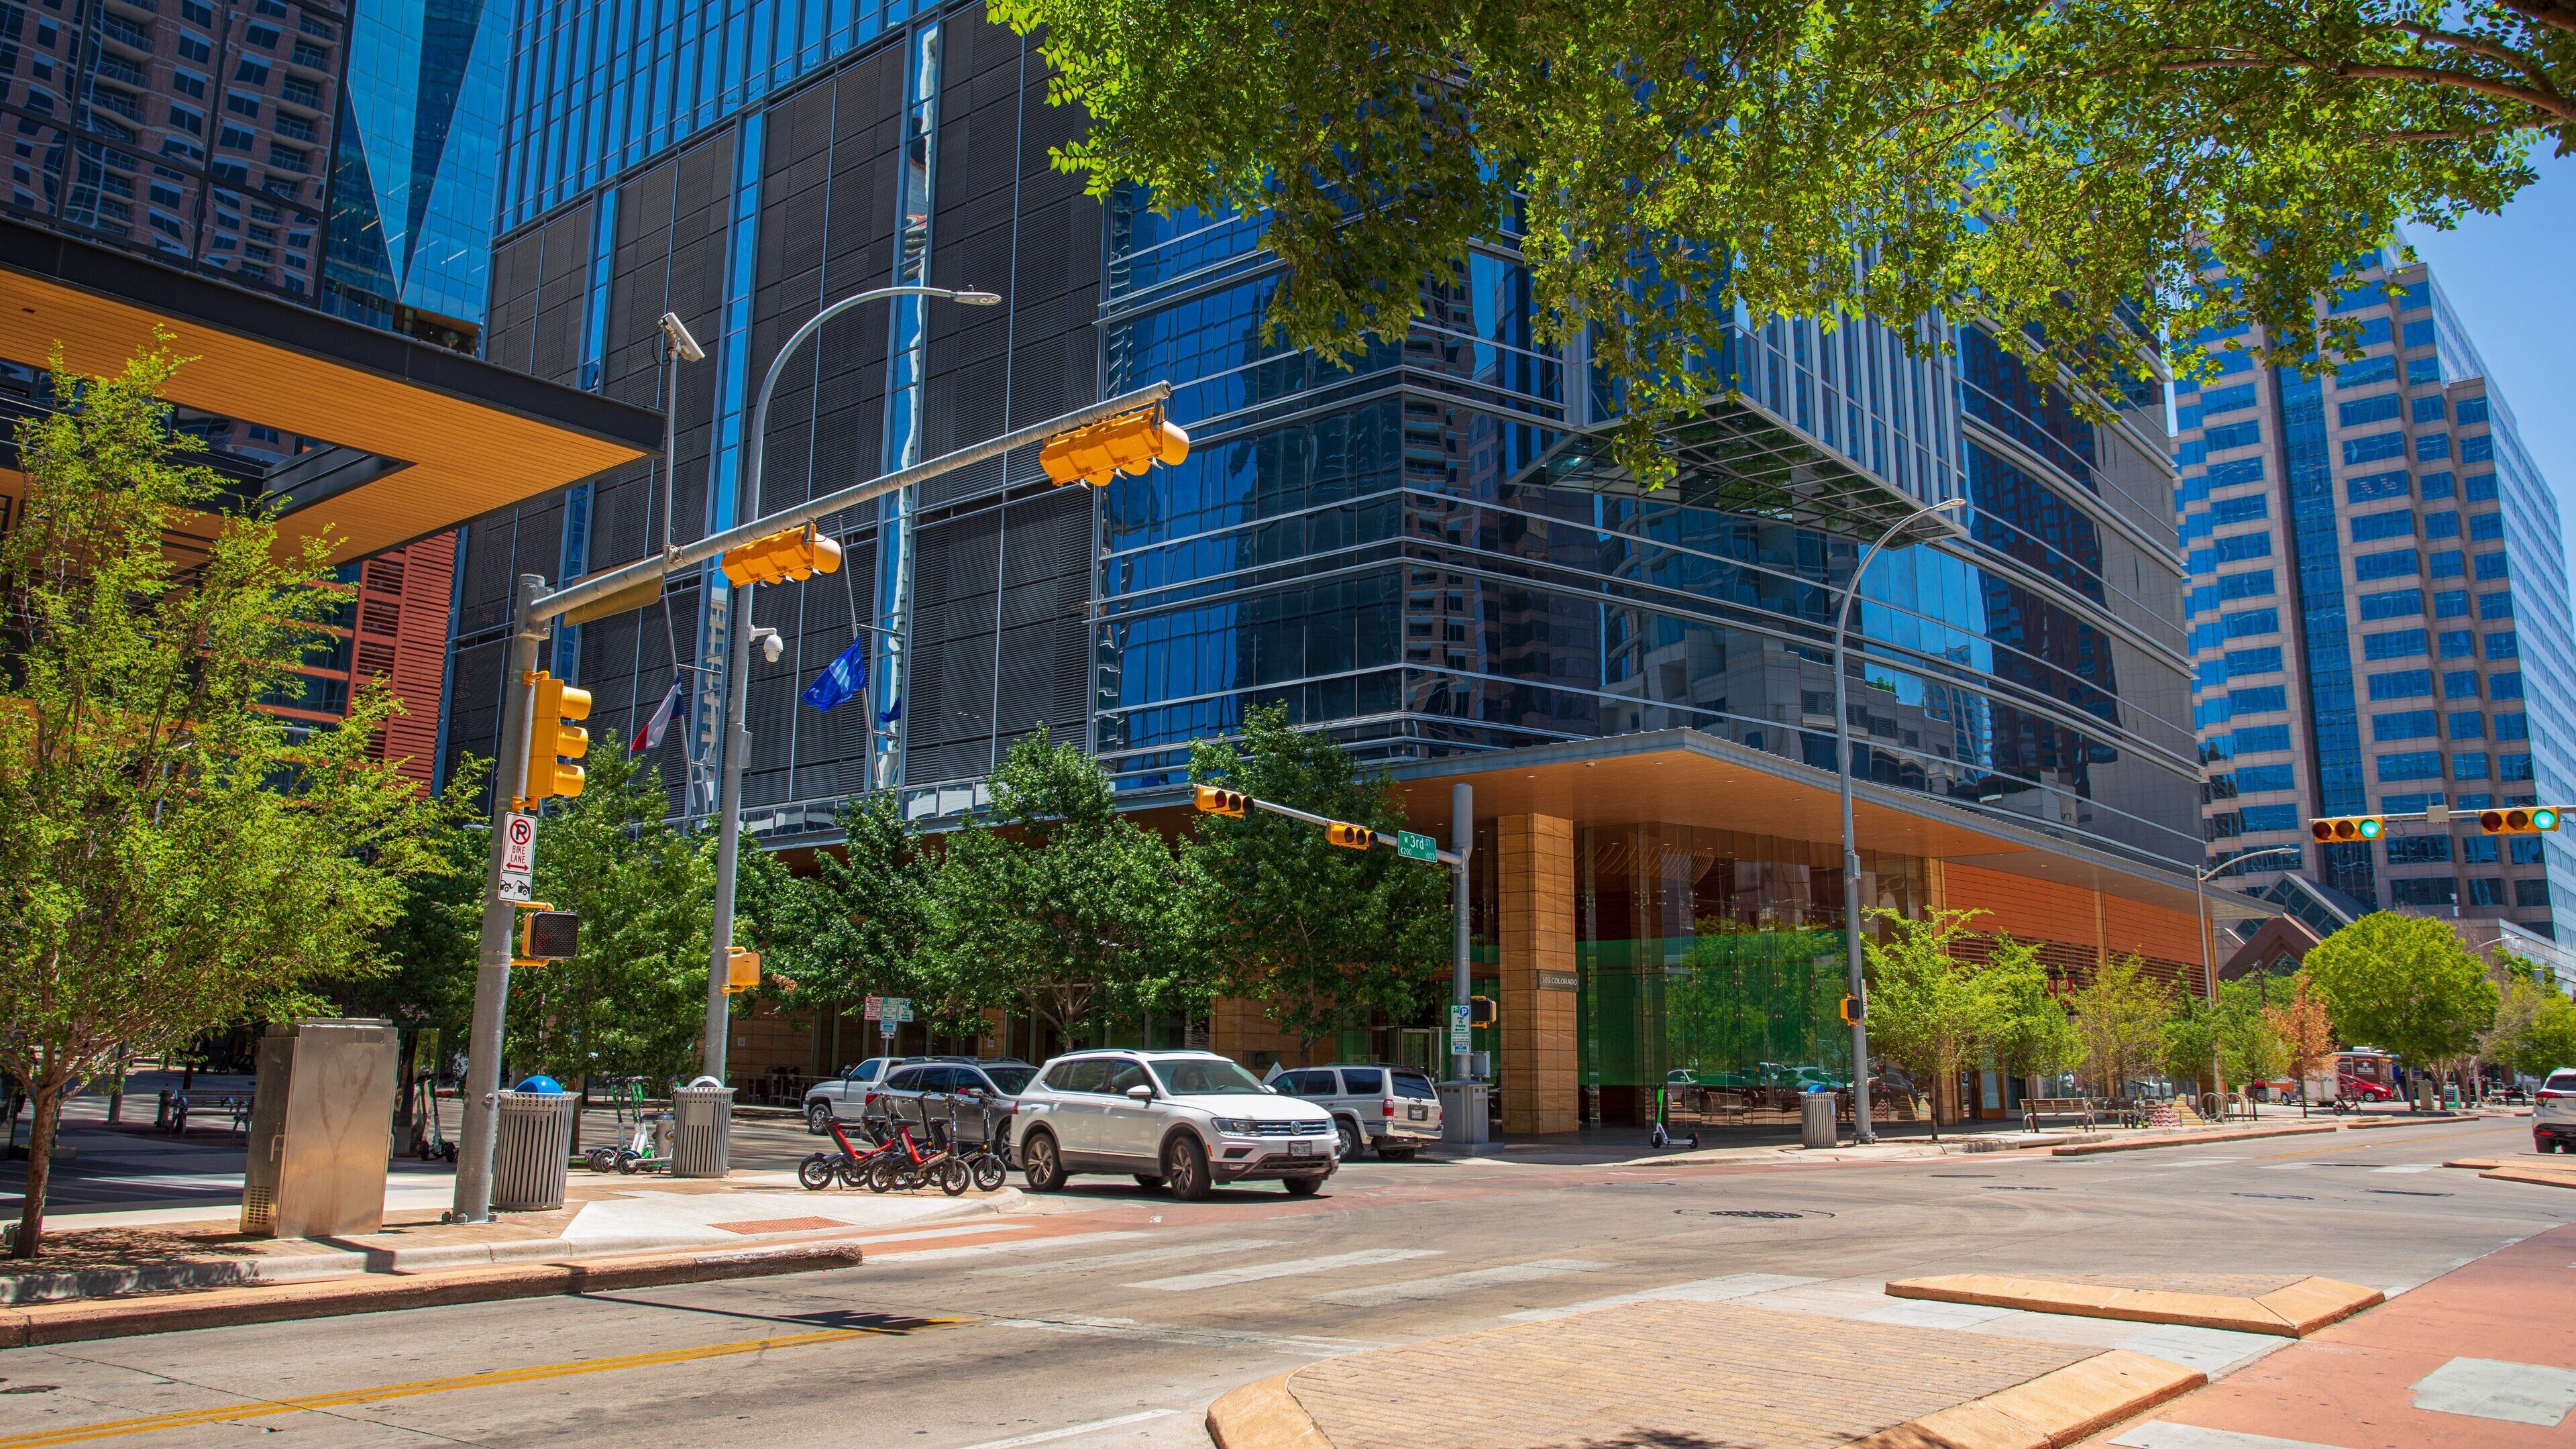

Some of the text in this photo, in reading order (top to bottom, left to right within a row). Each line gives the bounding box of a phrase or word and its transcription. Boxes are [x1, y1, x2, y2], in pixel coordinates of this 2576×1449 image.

[1410, 835, 1424, 850] 3rd
[1425, 839, 1431, 847] ST
[512, 845, 526, 855] BIKE
[1403, 847, 1412, 856] 200
[511, 854, 526, 864] LANE
[1551, 977, 1578, 985] COLORADO
